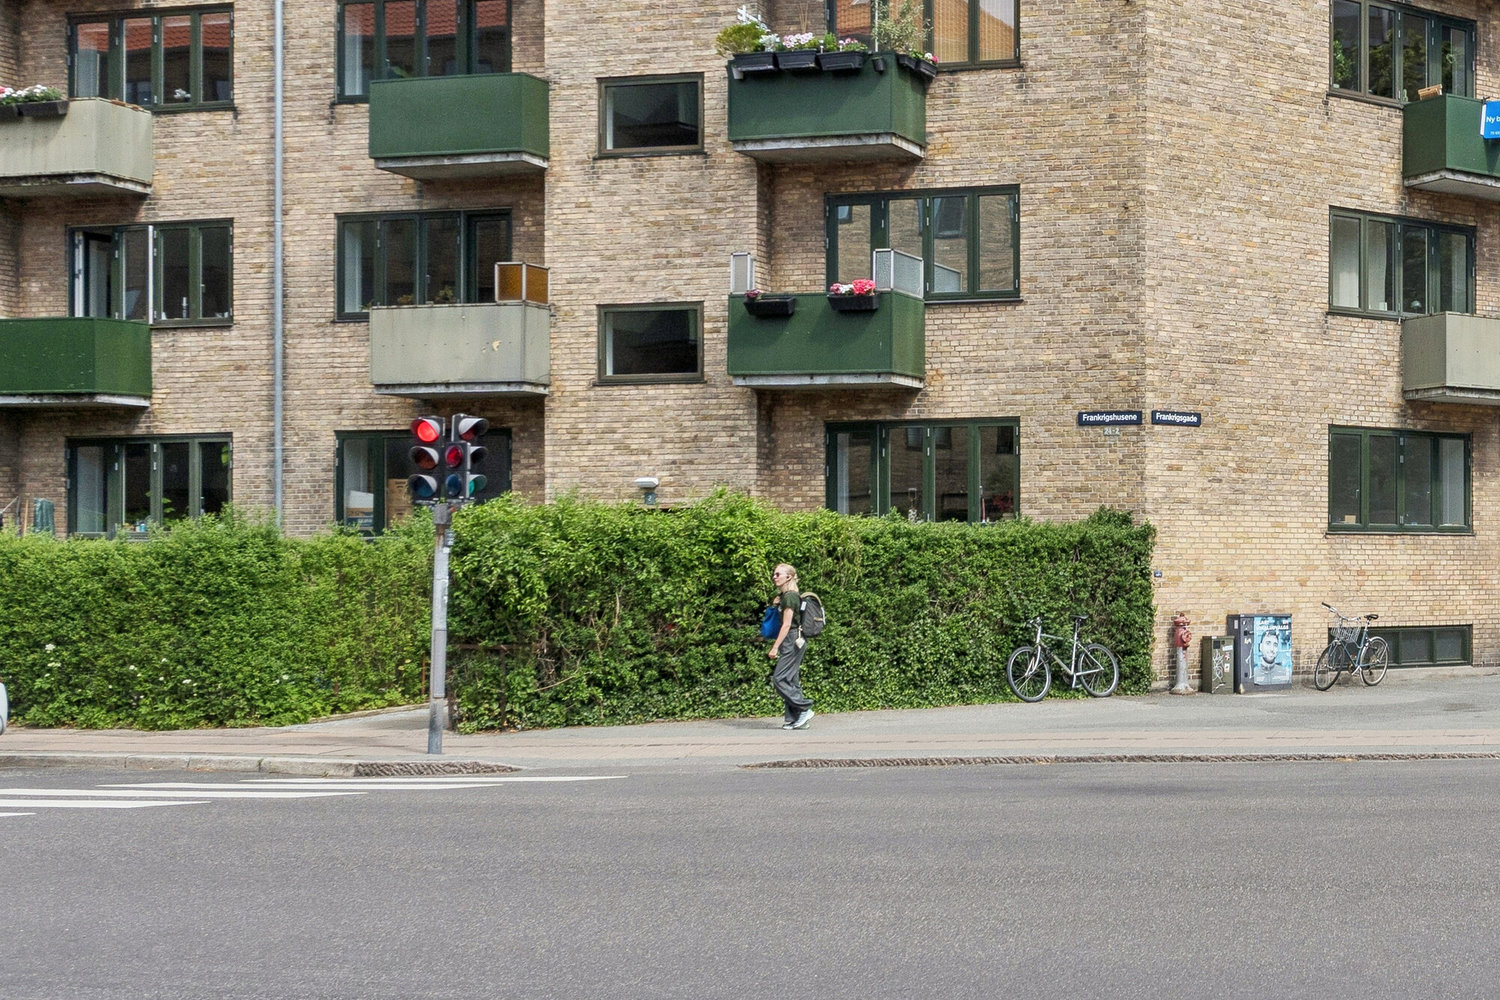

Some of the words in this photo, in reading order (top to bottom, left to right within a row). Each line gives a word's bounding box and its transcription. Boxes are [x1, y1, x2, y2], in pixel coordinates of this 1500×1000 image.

[1486, 116, 1496, 124] Ny
[1082, 413, 1138, 423] Frankrigshusene
[1155, 412, 1198, 423] Frankrigsgade
